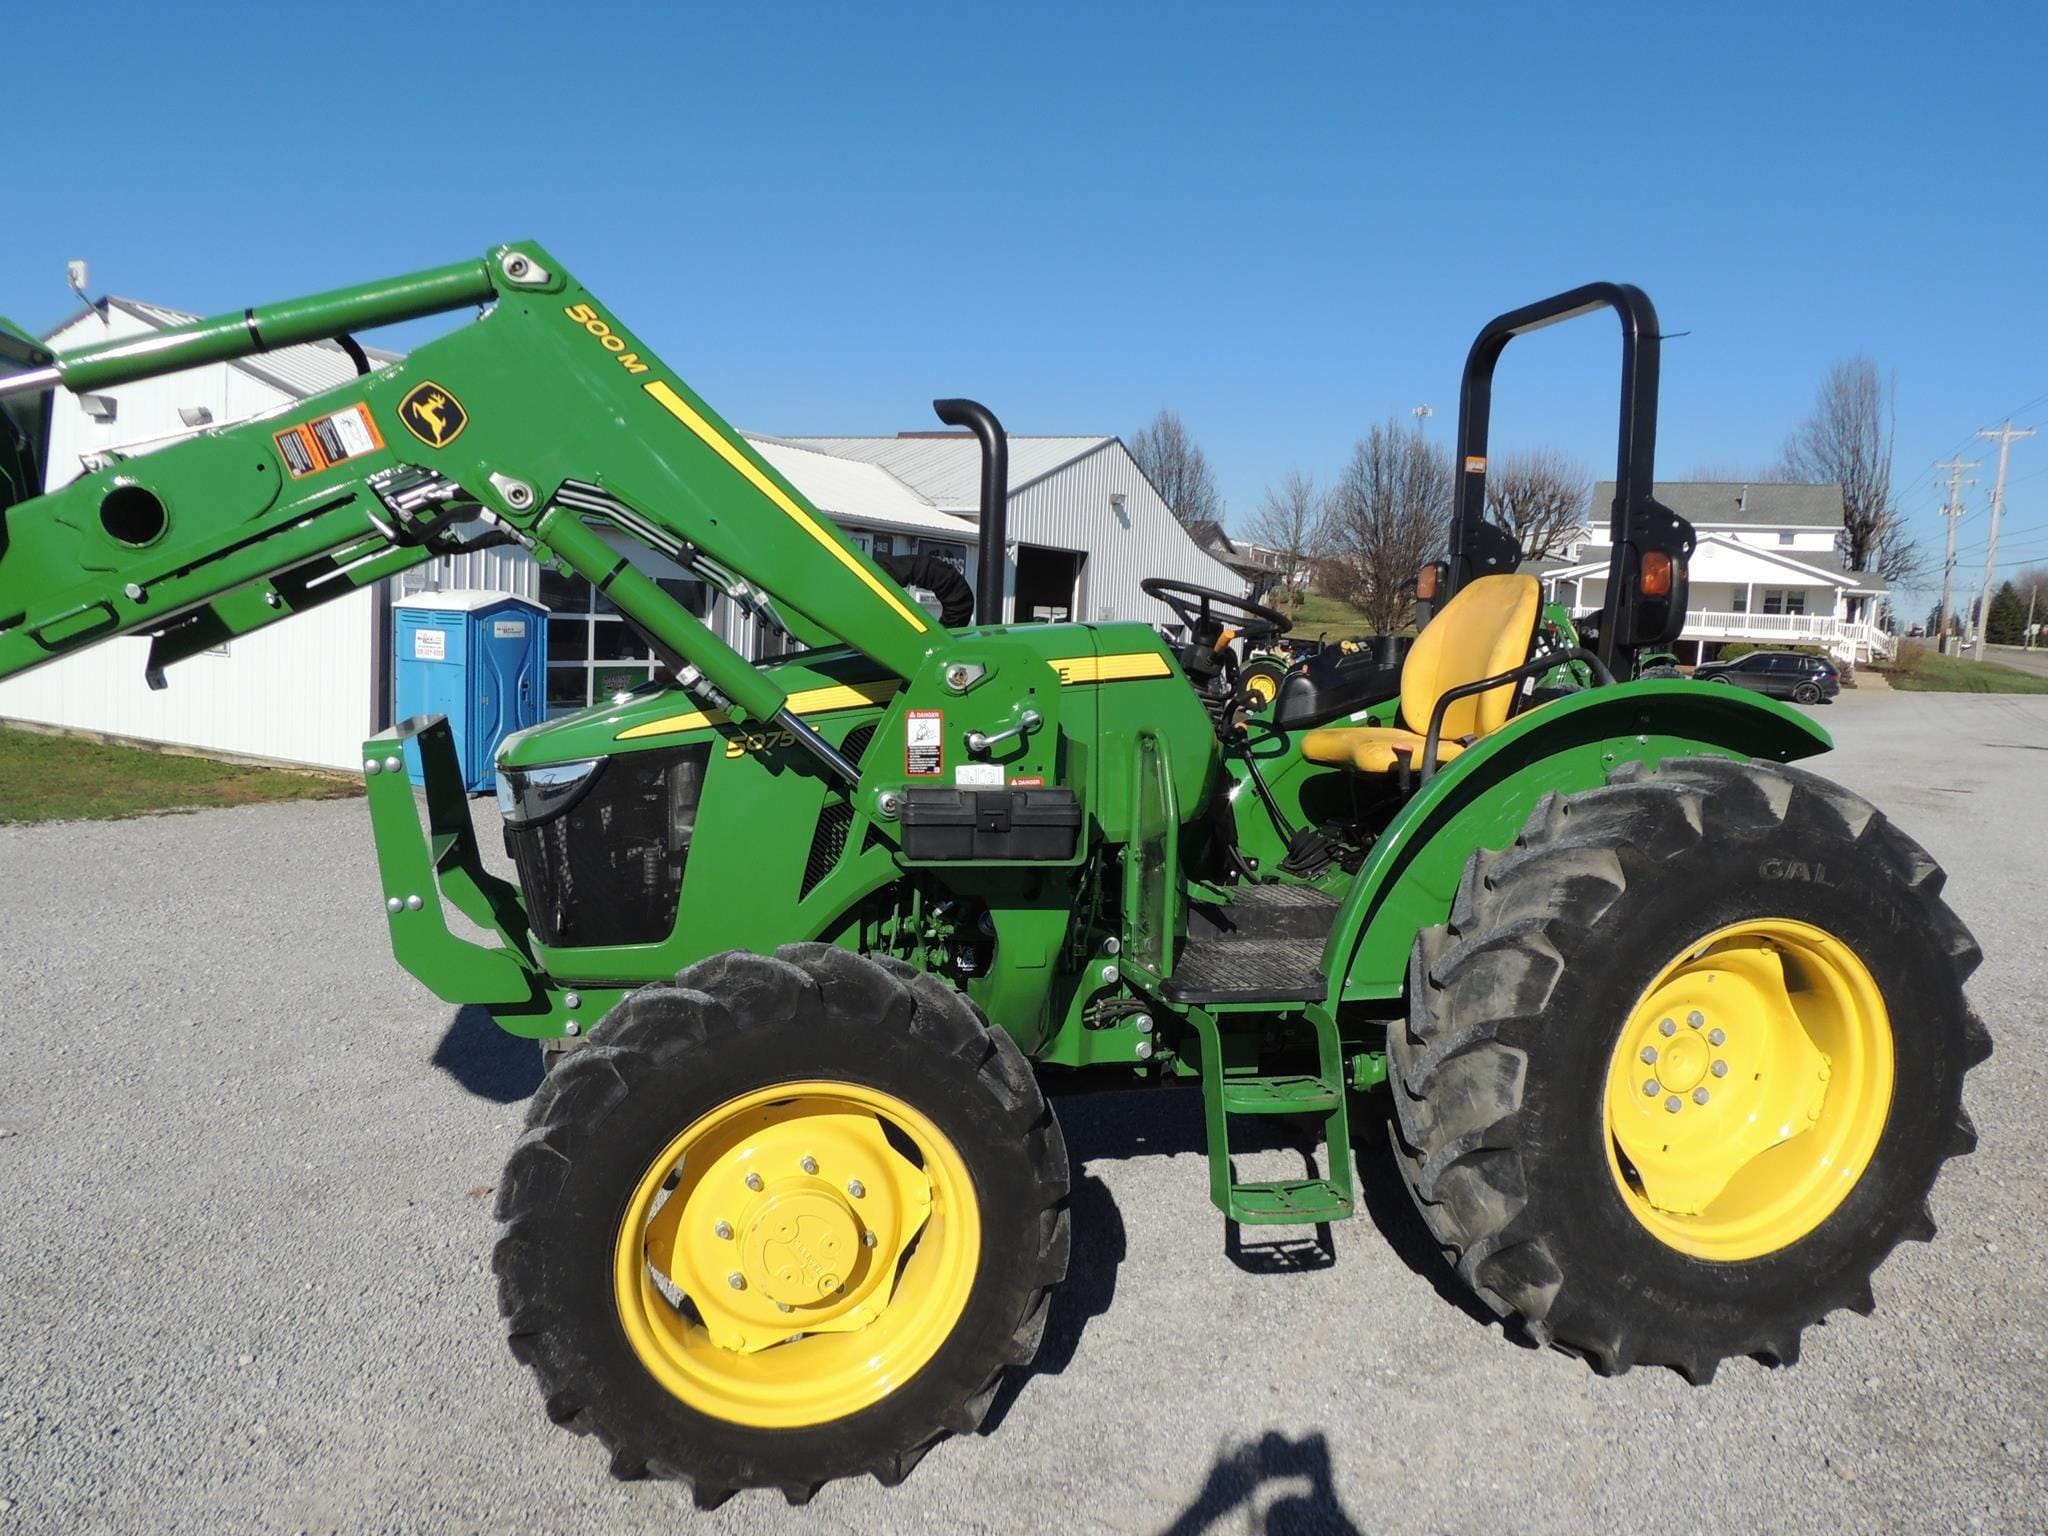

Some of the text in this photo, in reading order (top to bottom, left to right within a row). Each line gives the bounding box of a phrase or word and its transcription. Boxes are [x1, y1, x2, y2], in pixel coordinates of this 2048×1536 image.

[916, 711, 940, 719] DANGER
[724, 727, 820, 759] 5075
[1758, 857, 1836, 888] GAL
